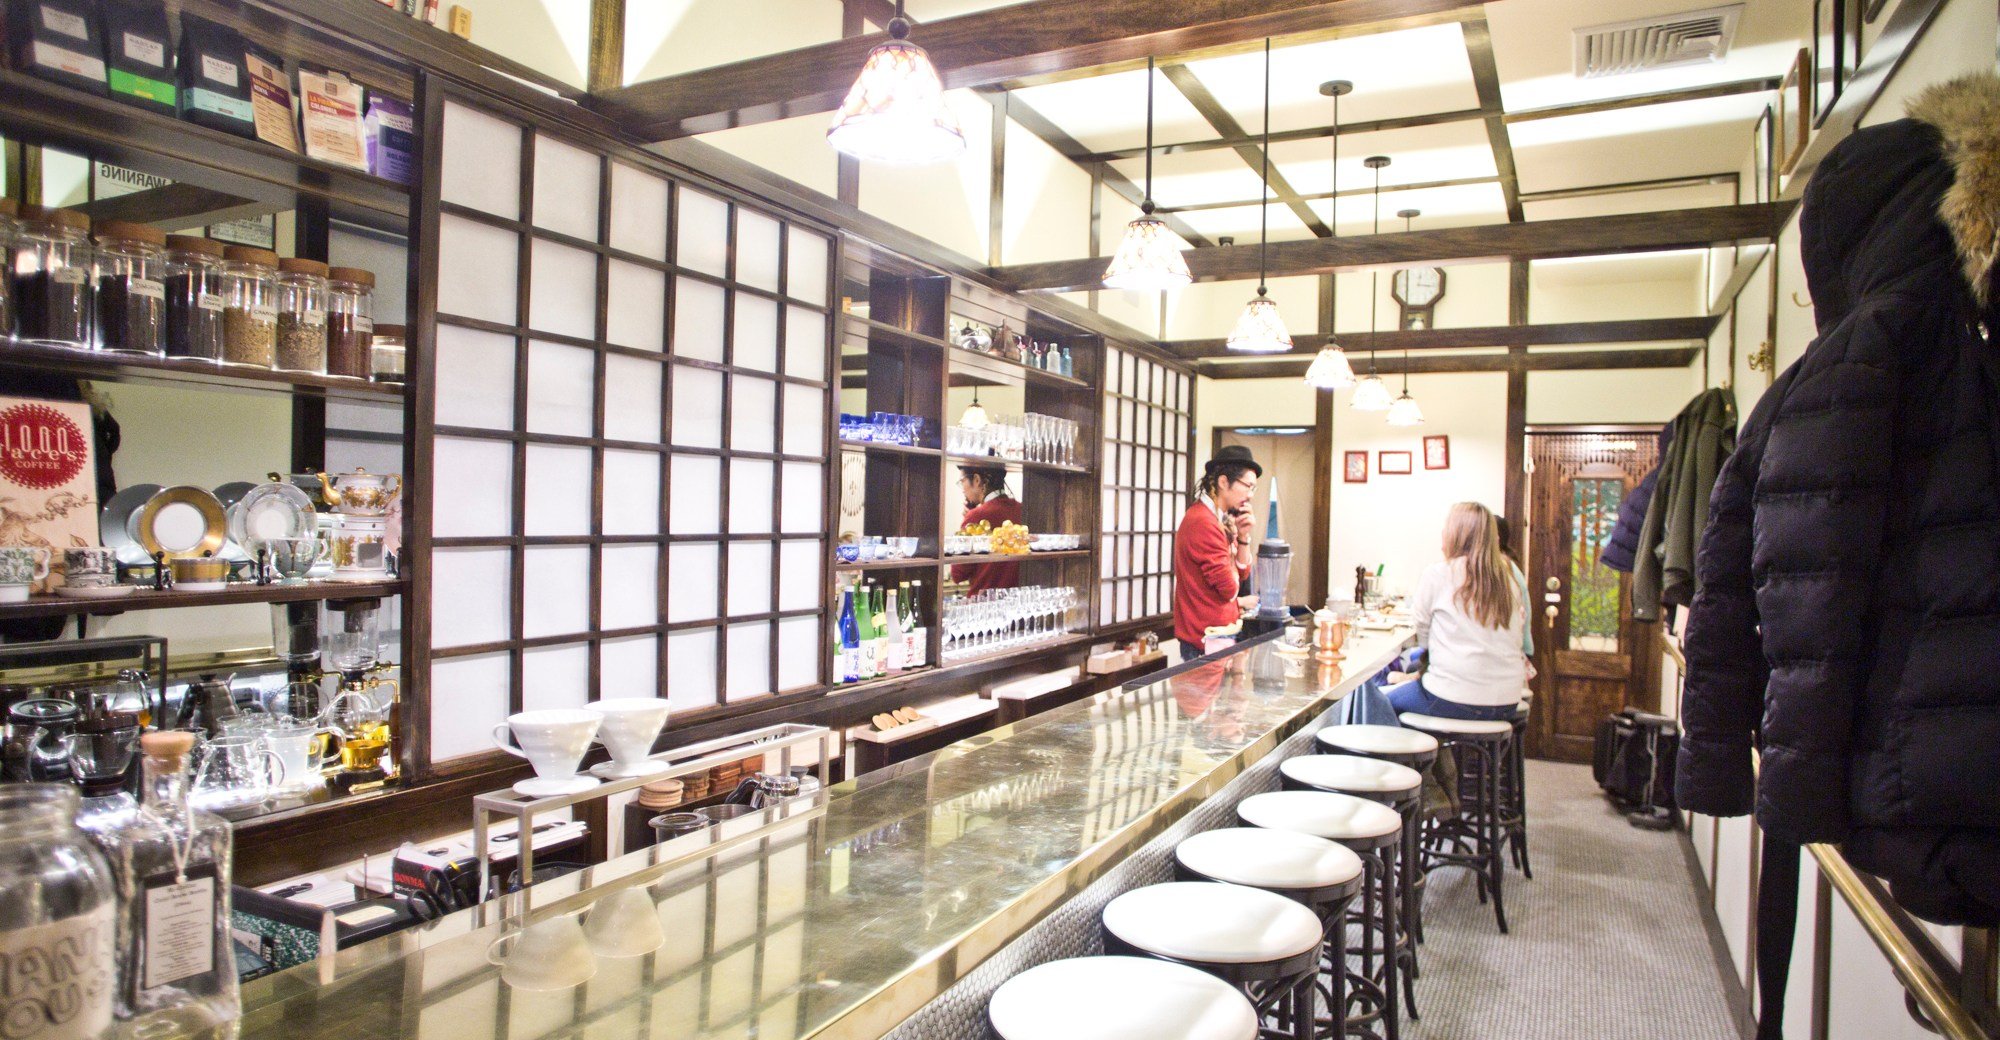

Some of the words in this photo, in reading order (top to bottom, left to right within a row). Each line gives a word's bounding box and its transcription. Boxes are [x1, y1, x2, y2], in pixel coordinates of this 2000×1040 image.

[4, 422, 69, 455] 1000
[15, 460, 61, 470] COFFEE
[394, 872, 427, 890] BONMA
